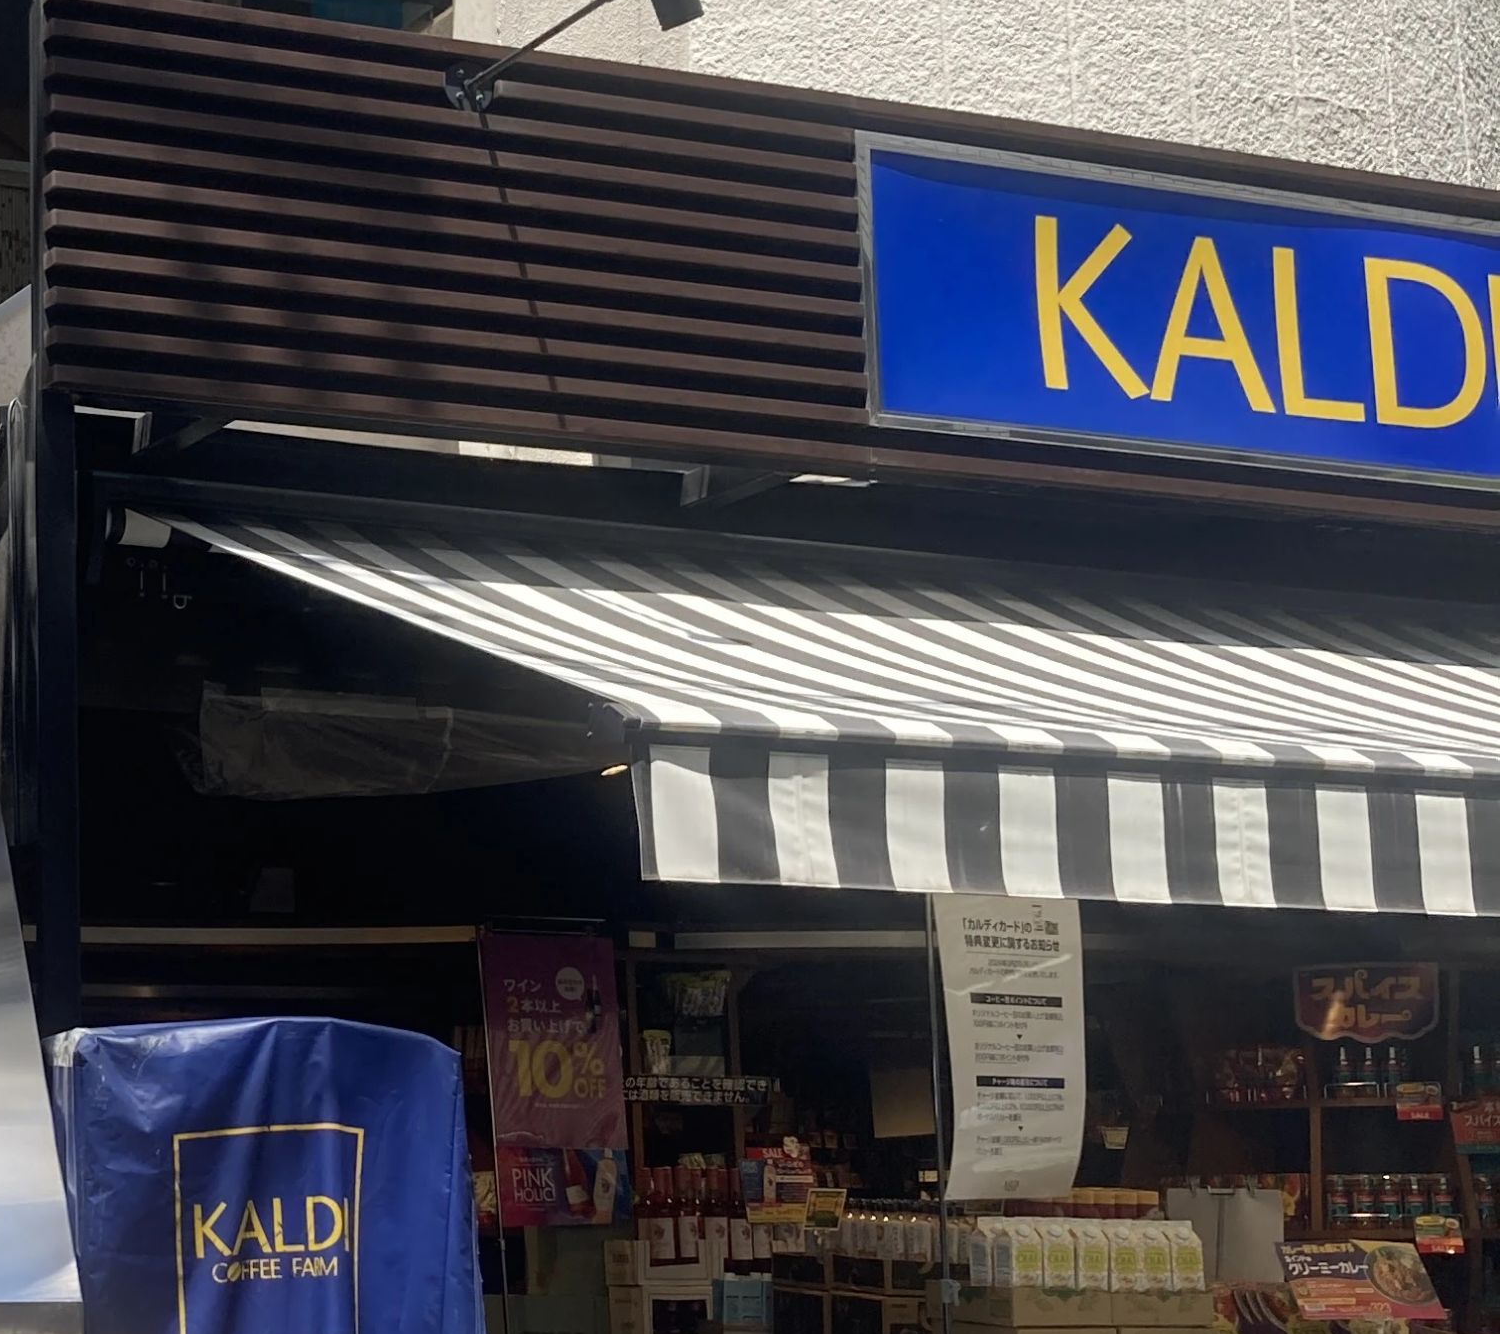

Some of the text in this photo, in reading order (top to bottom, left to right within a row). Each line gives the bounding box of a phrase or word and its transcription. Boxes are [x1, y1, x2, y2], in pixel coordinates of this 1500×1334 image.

[503, 979, 541, 993] ワイン
[1310, 969, 1424, 1000] スパイス
[512, 1168, 555, 1188] PINK
[194, 1195, 349, 1259] KALDI
